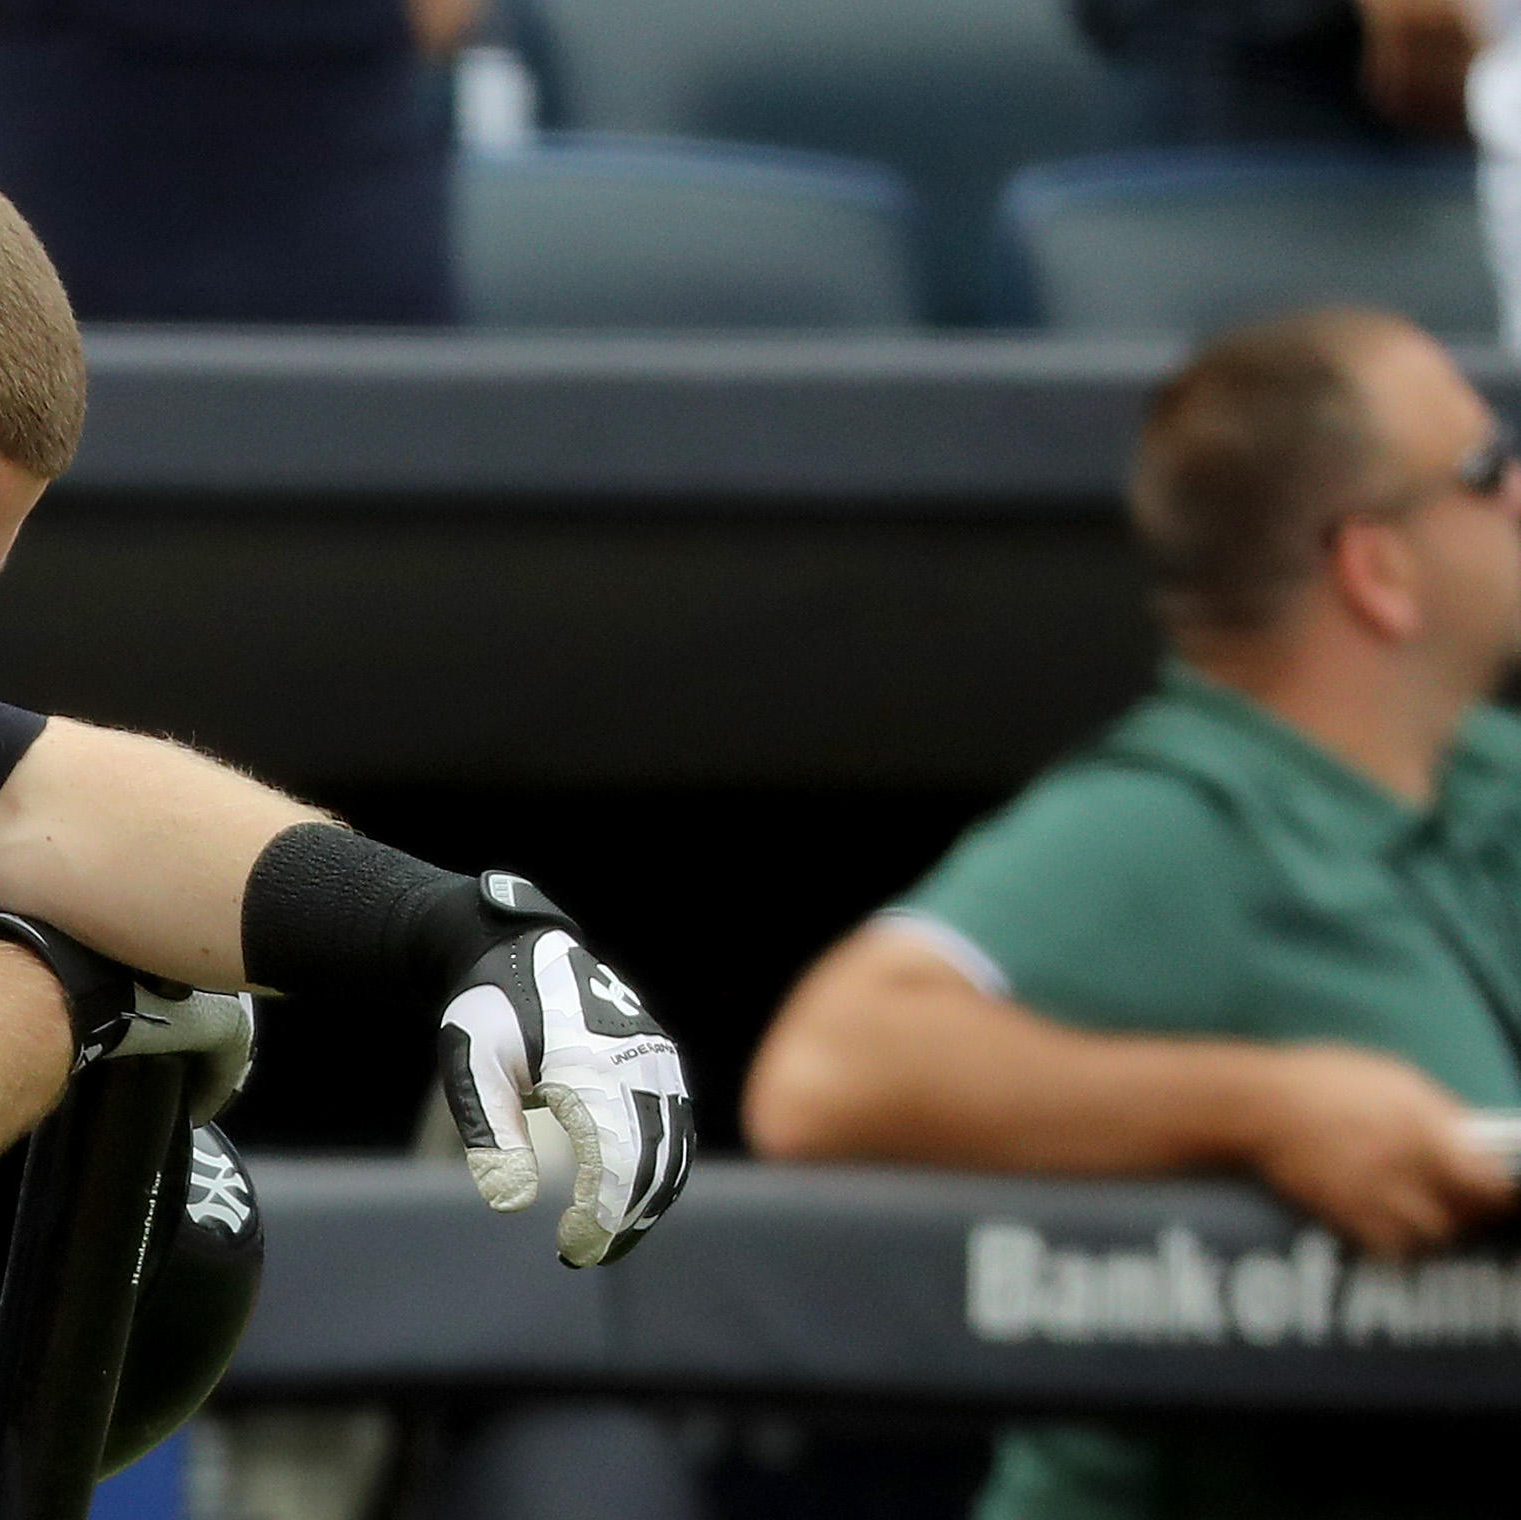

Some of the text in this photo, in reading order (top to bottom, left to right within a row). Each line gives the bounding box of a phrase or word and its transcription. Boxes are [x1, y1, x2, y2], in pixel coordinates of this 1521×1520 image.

[131, 1170, 162, 1285] Handcrafted For
[966, 1220, 1224, 1345] Bank
[1230, 1224, 1338, 1346] of
